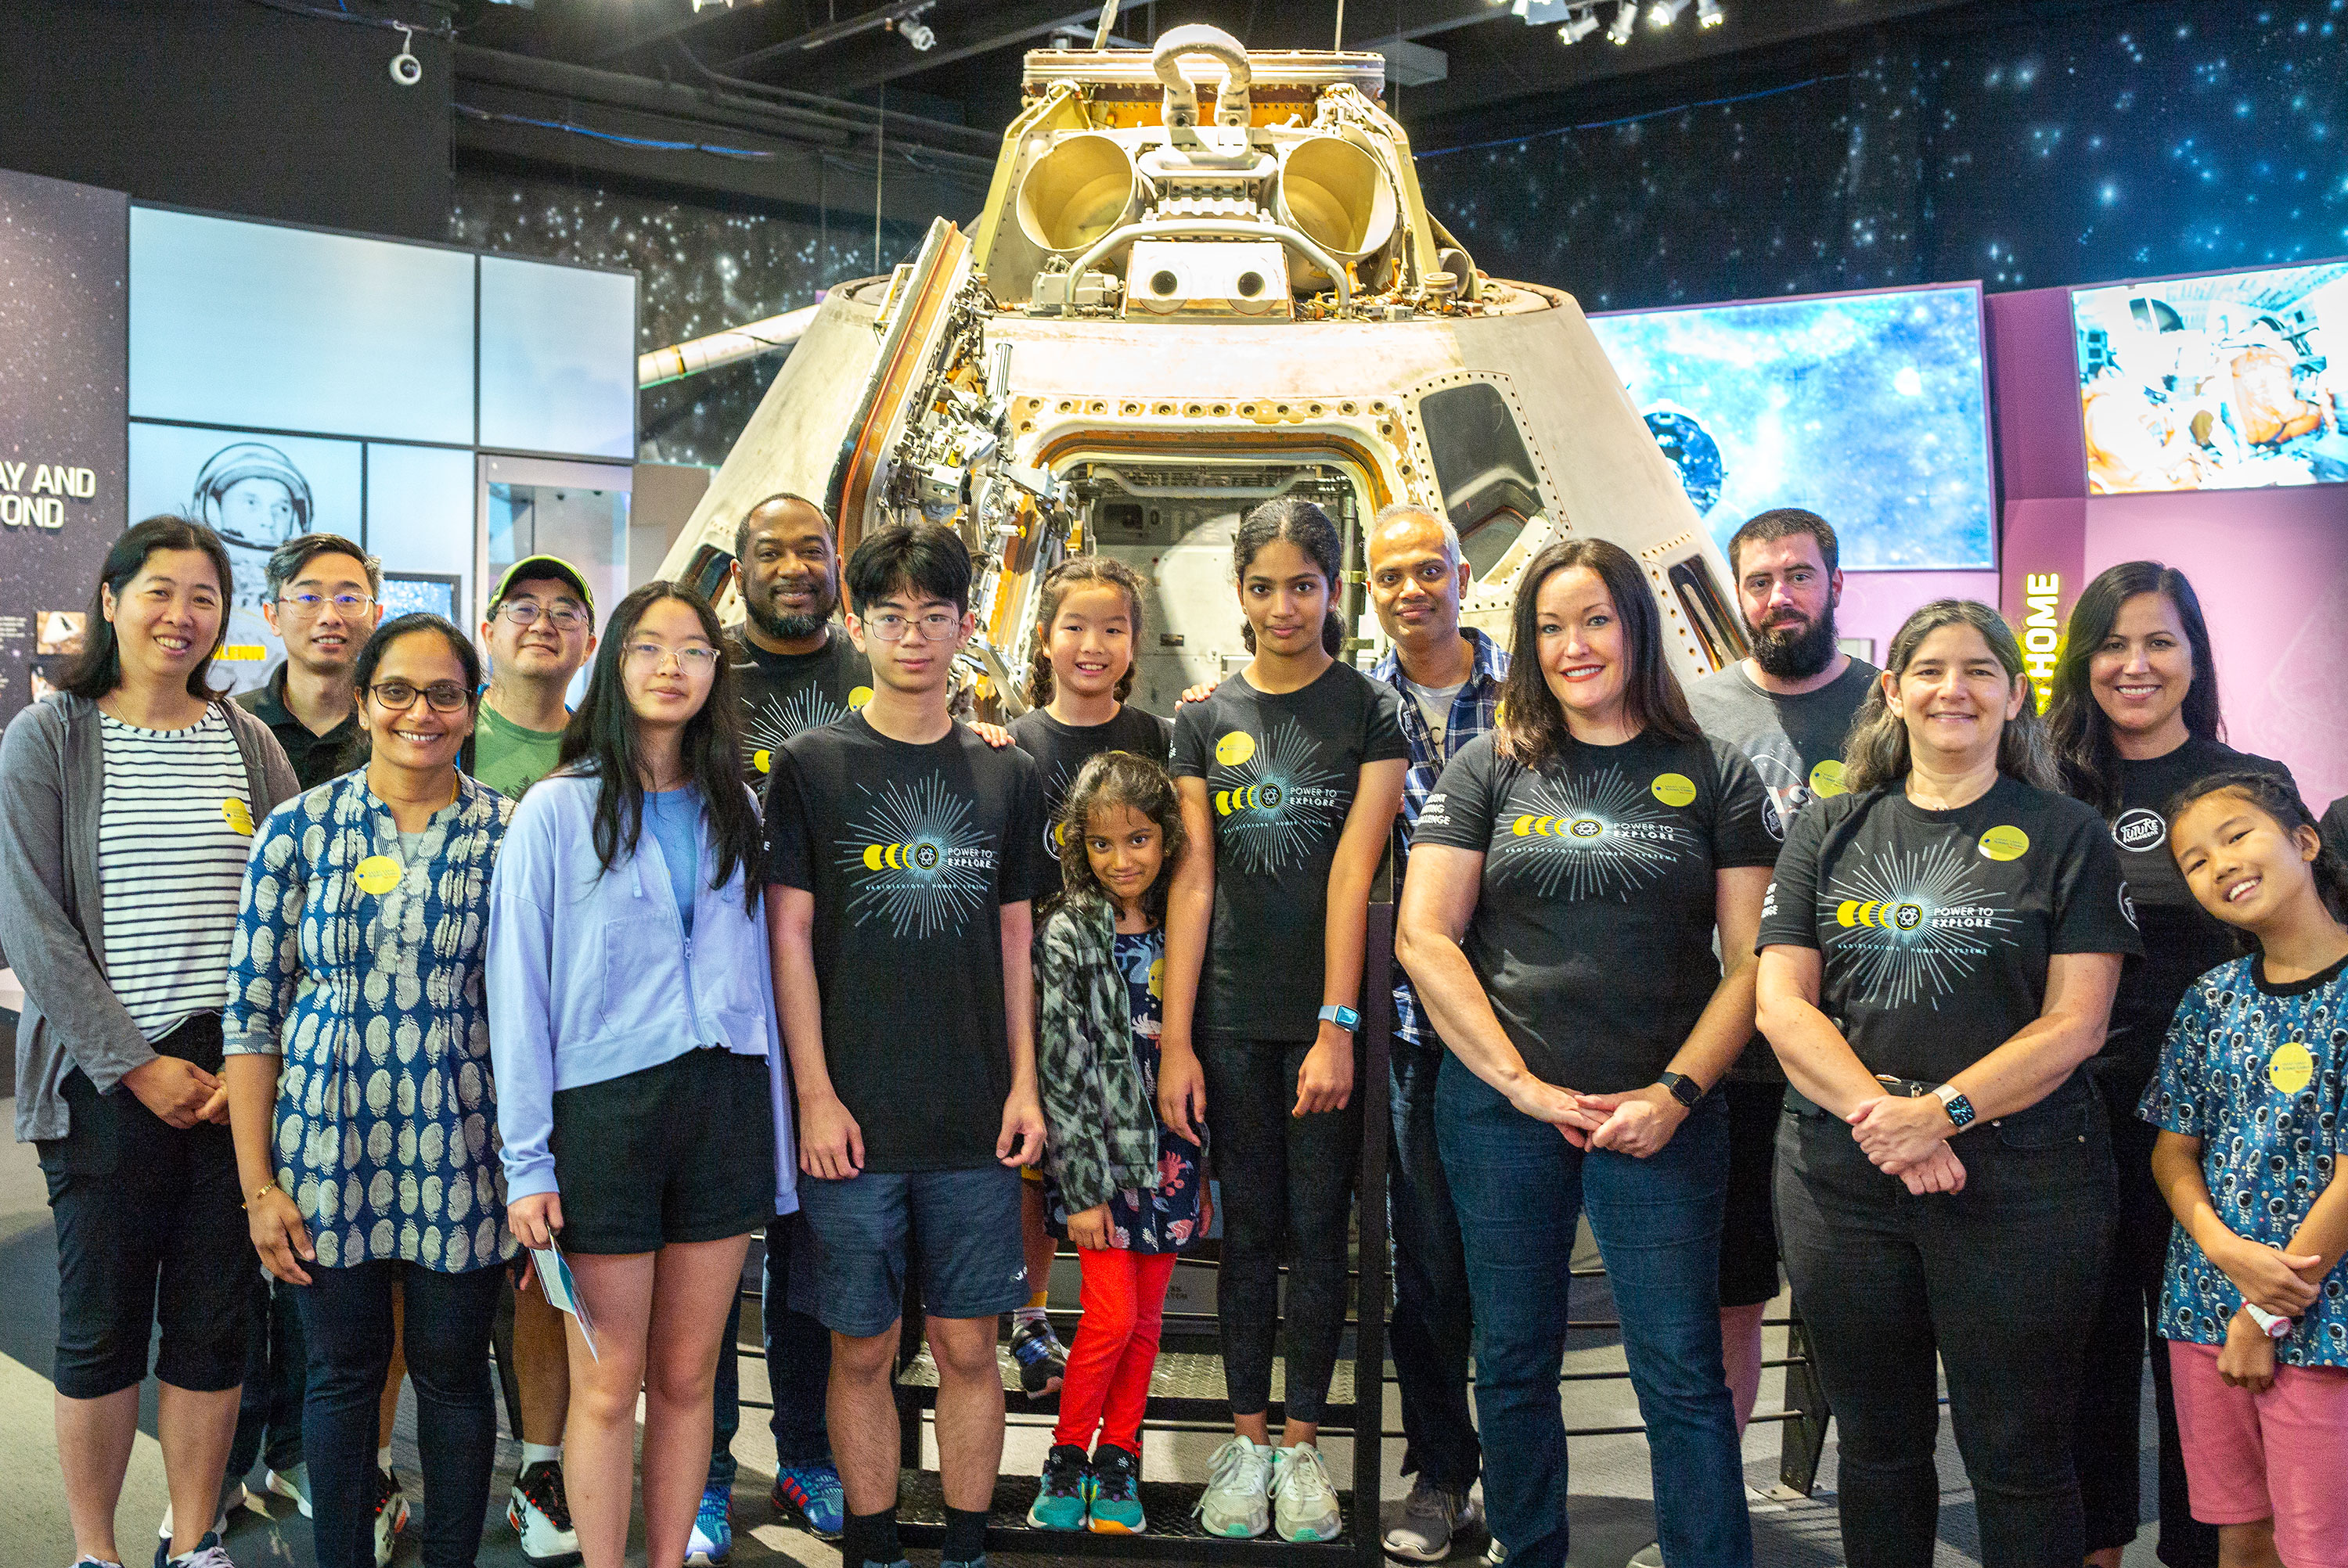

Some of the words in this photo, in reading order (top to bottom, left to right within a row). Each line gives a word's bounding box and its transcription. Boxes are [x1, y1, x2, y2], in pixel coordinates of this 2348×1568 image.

[31, 464, 96, 498] AND
[0, 494, 64, 529] OND
[2026, 573, 2059, 678] HOME
[1290, 786, 1322, 797] POWER
[1324, 789, 1338, 798] TO
[1290, 797, 1335, 807] EXPLORE
[1613, 822, 1655, 831] POWER
[1658, 824, 1674, 833] TO
[1613, 830, 1675, 842] EXPLORE
[947, 847, 979, 858] POWER
[981, 849, 993, 859] TO
[948, 858, 992, 869] EXPLORE
[1933, 907, 1974, 917] POWER
[1978, 907, 1994, 917] TO
[1932, 918, 1993, 929] EXPLORE
